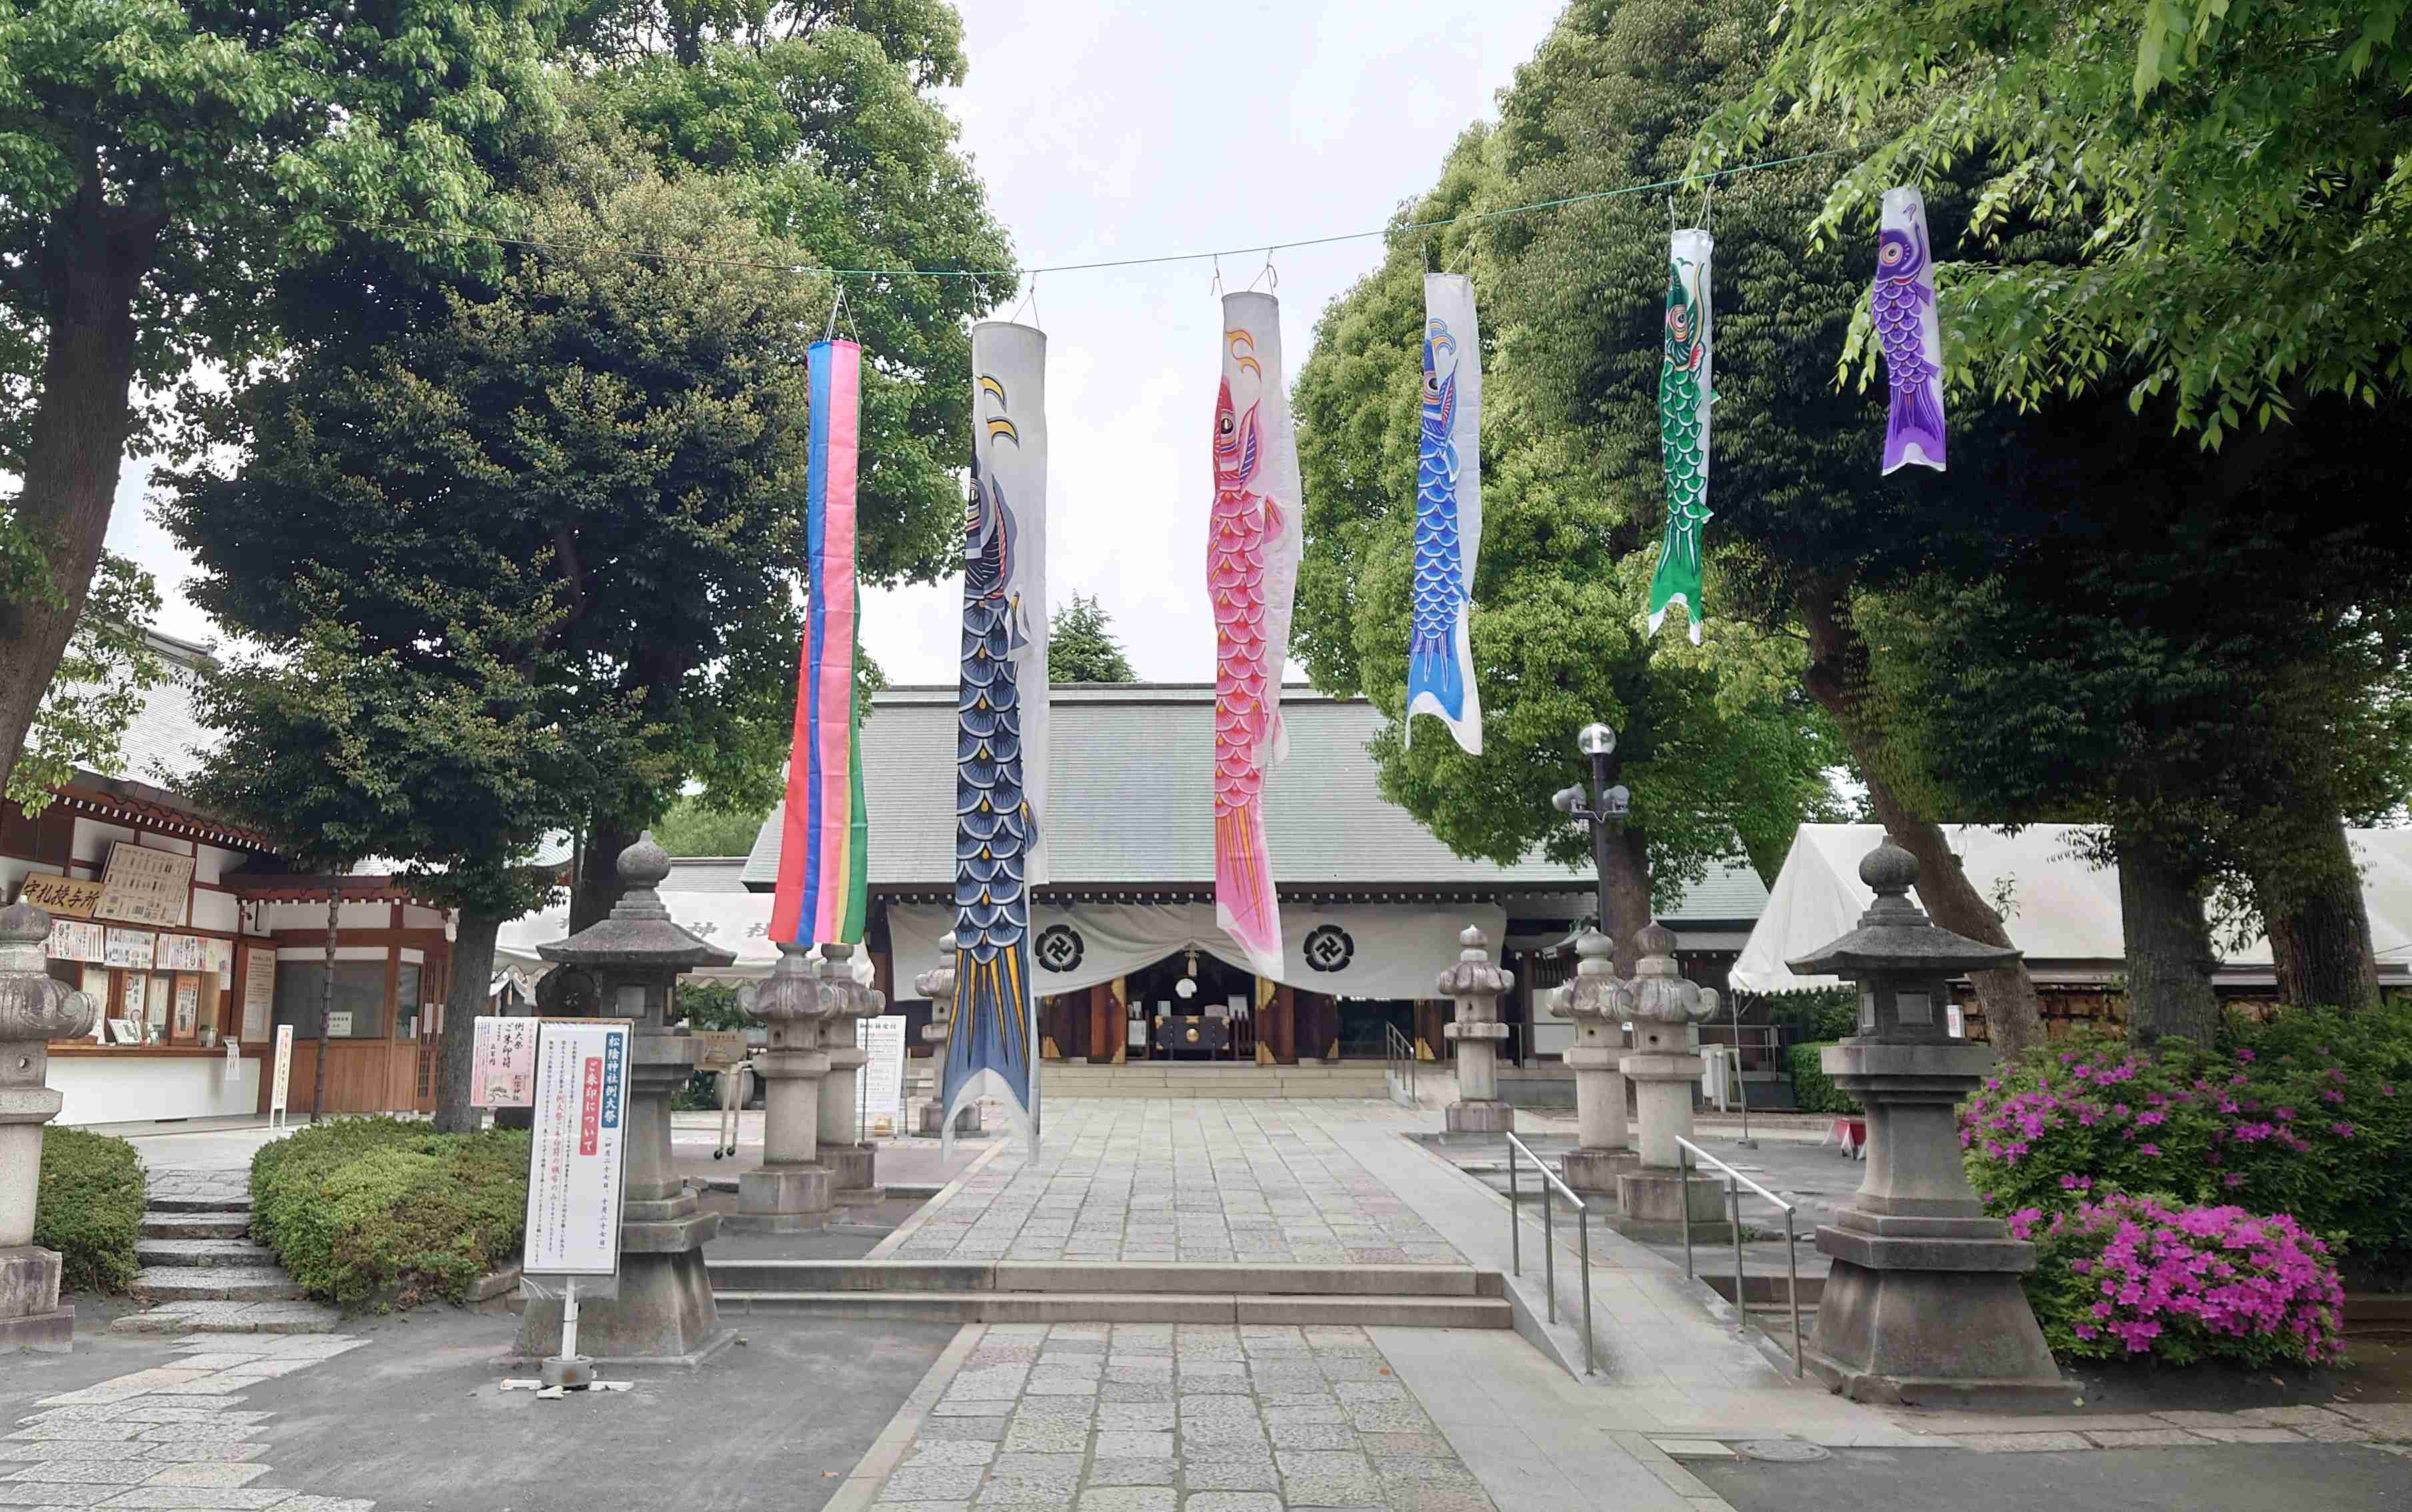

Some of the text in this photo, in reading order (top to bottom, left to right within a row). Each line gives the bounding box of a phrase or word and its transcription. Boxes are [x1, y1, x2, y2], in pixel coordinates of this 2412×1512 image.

[22, 879, 101, 911] 守札授与所
[583, 1061, 598, 1151] ご朱印について
[604, 1035, 620, 1123] 松陰神社例大祭
